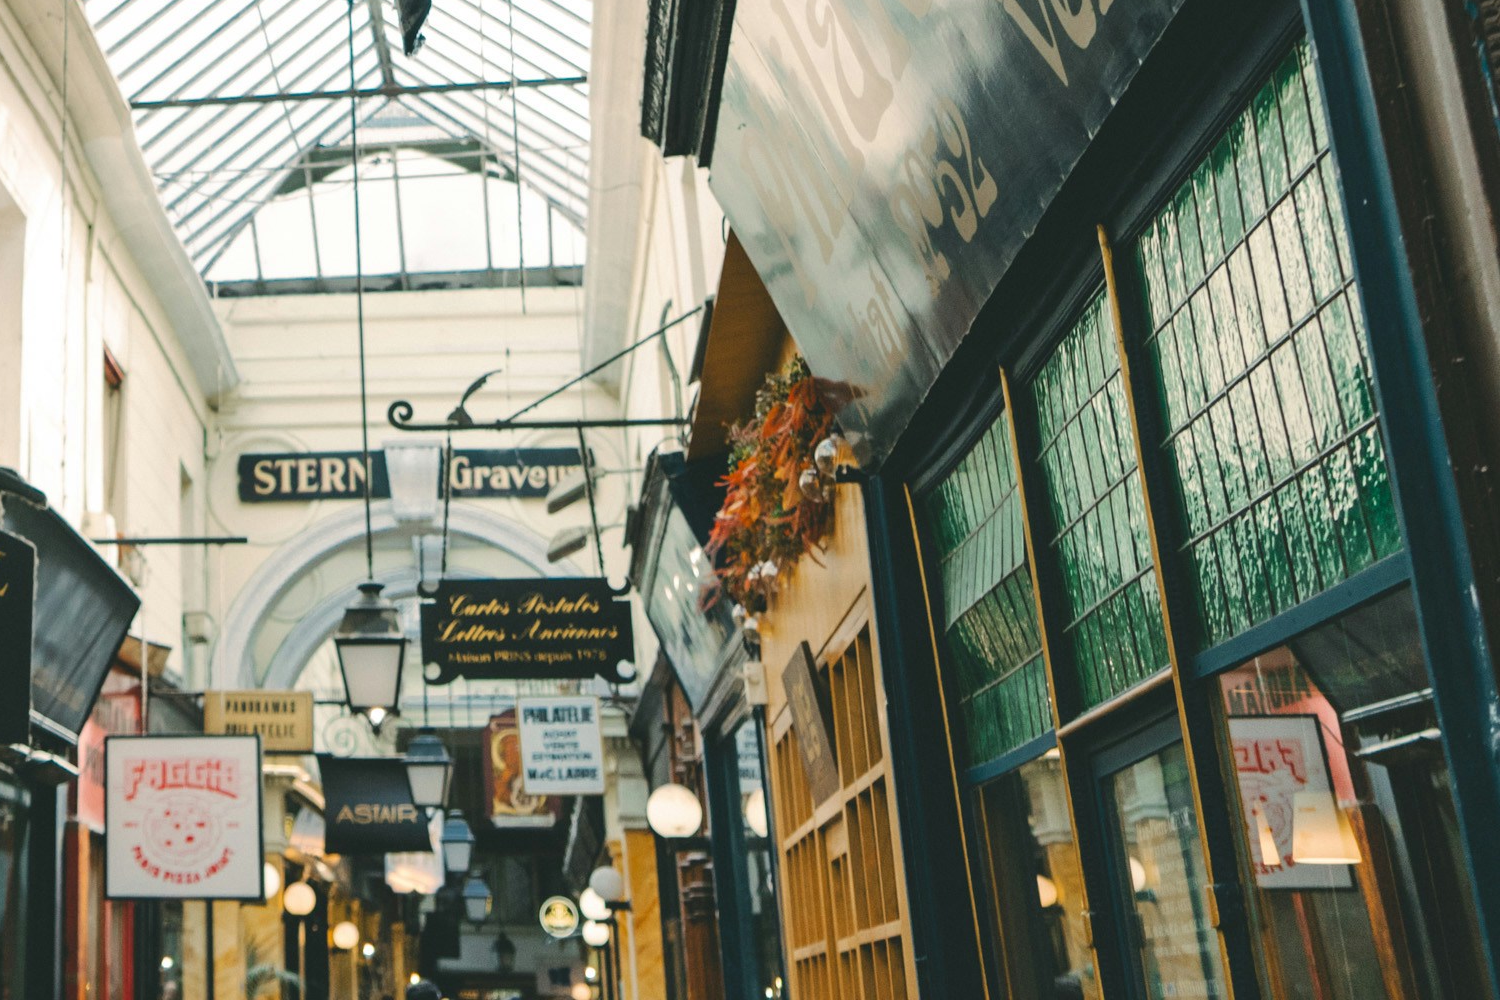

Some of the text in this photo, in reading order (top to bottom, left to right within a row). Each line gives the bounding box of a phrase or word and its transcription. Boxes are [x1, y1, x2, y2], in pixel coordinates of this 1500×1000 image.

[253, 454, 582, 496] STERN Graveu
[449, 594, 510, 616] Cartes
[434, 619, 506, 643] Lettres
